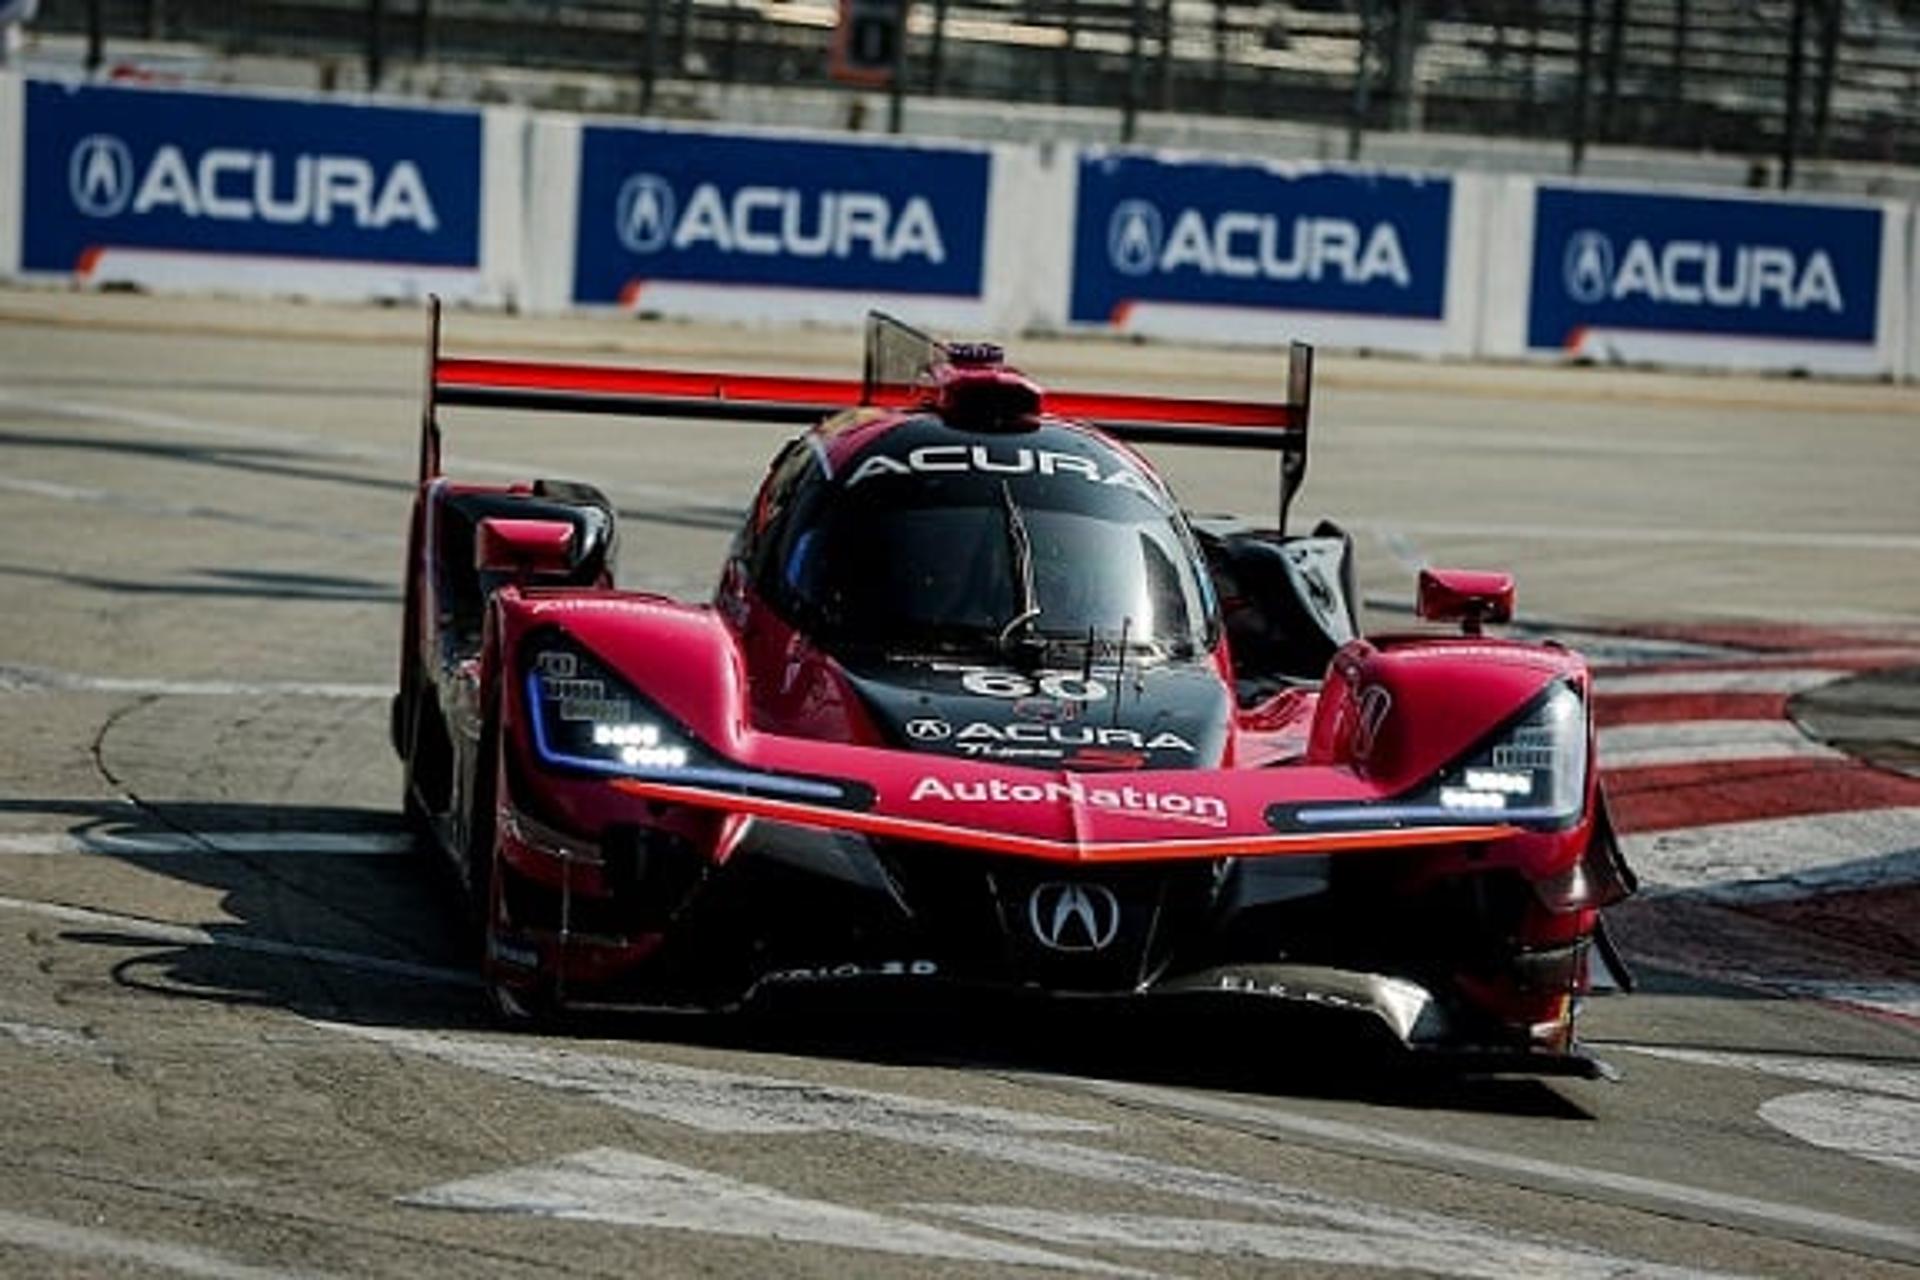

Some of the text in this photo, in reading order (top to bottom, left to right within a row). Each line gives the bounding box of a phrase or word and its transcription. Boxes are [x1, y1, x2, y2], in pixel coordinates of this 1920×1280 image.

[133, 145, 440, 233] ACURA
[674, 182, 946, 265] ACURA
[1160, 208, 1411, 288] ACURA
[1613, 238, 1844, 312] ACURA
[845, 444, 1166, 514] ACURA
[962, 669, 1108, 702] 60
[956, 721, 1195, 751] ACURA
[910, 776, 1228, 818] AutoNation
